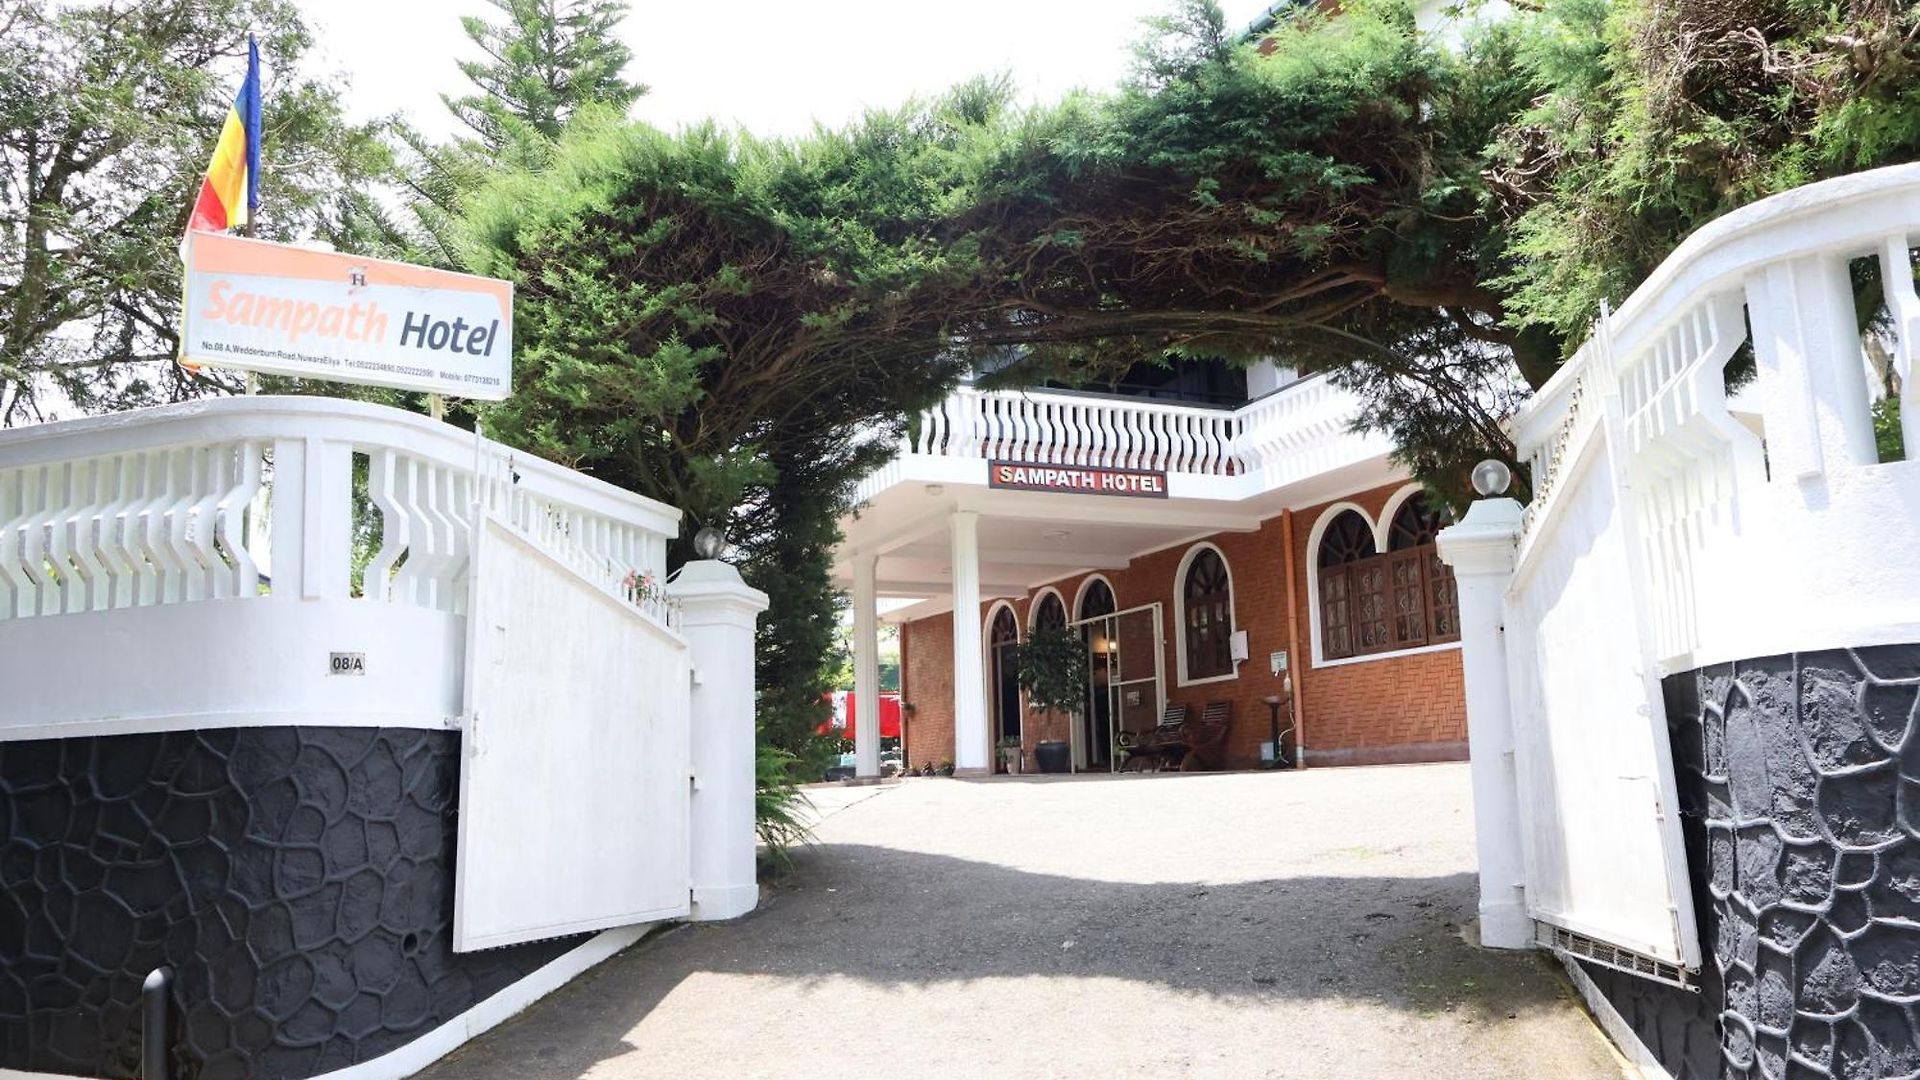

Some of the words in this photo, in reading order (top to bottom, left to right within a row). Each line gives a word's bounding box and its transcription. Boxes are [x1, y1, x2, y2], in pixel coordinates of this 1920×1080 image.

[203, 280, 388, 343] Sampath
[400, 311, 499, 357] Hotel
[1000, 465, 1095, 489] SAMPATH
[1102, 474, 1162, 492] HOTEL
[333, 657, 363, 670] 08/A
